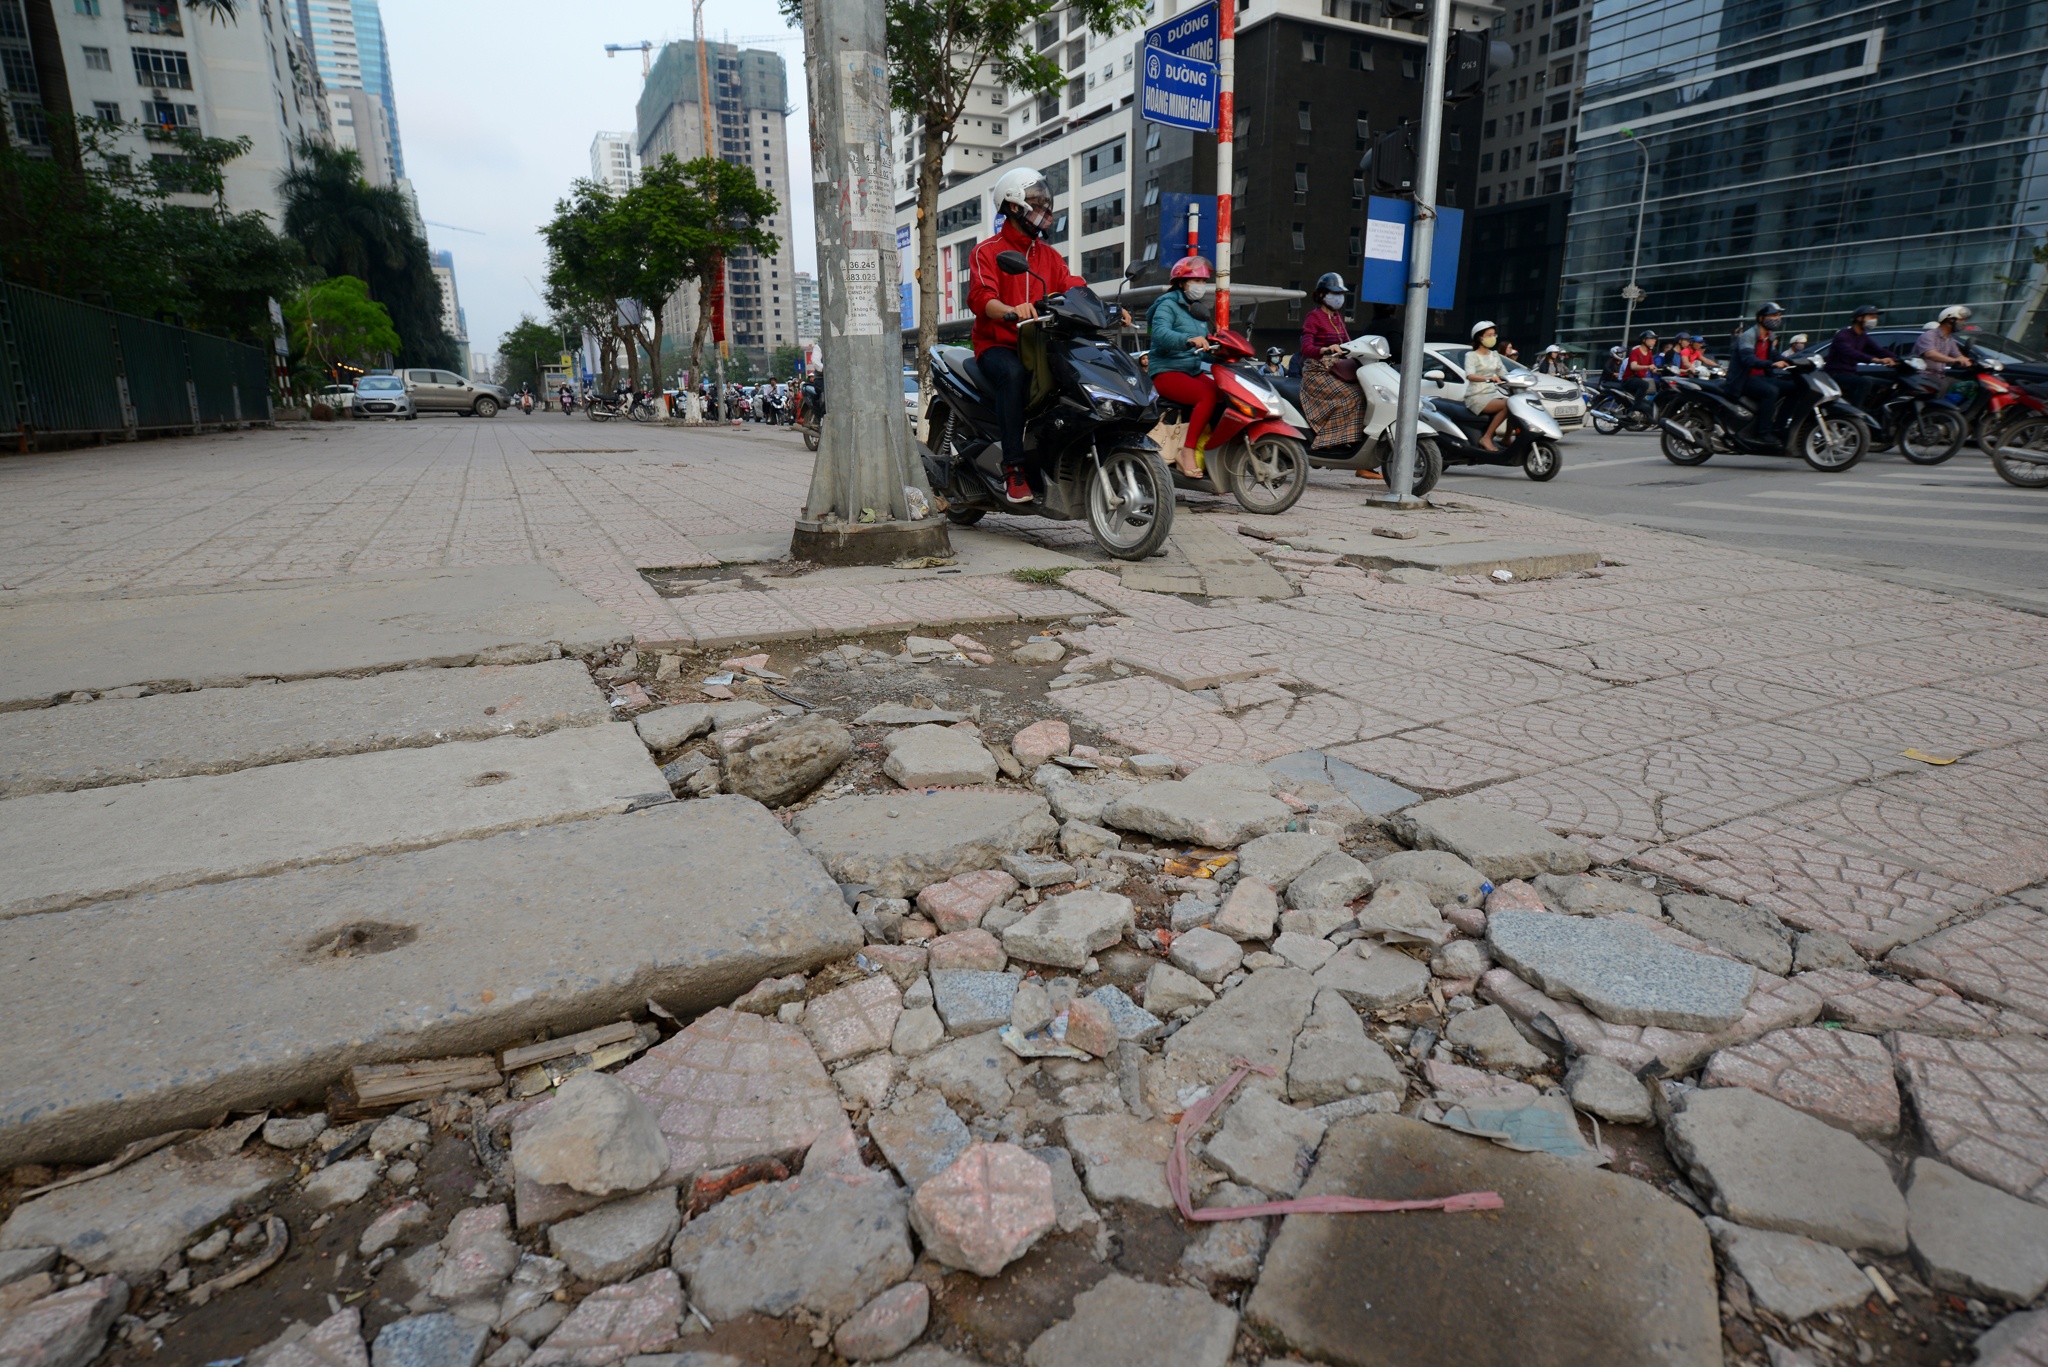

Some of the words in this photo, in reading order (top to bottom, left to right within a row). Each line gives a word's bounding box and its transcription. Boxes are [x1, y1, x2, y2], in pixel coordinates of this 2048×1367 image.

[1168, 14, 1209, 43] ĐƯỜNG
[1165, 63, 1207, 87] ĐƯỜNG
[1145, 84, 1168, 115] HOÀNG
[1169, 93, 1190, 119] MINH
[1190, 95, 1211, 123] GIÁM
